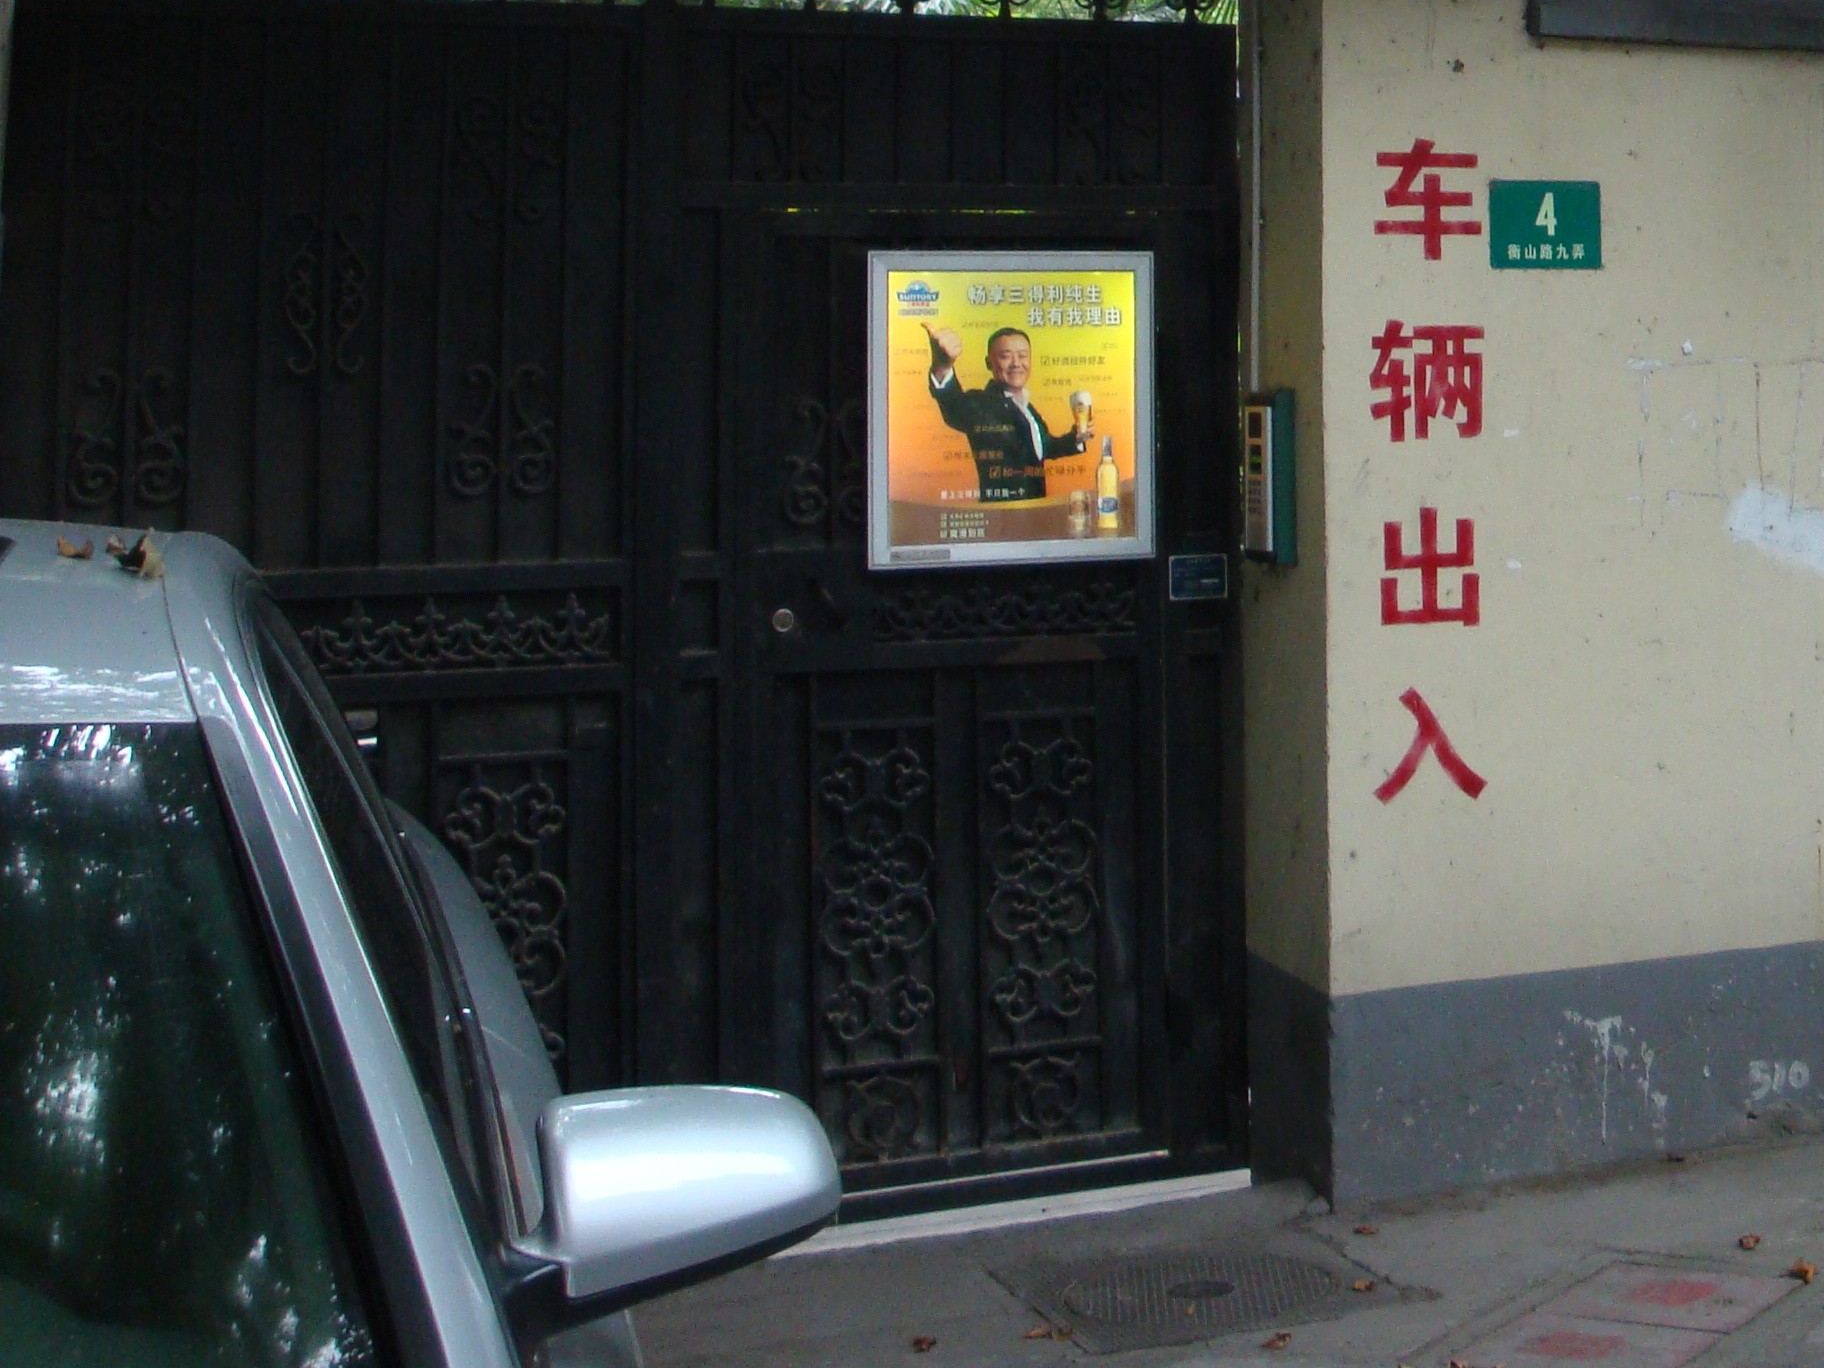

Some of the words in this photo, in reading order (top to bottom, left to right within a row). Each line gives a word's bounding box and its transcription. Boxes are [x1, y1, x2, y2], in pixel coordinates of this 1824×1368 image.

[1535, 192, 1557, 236] 4
[1507, 243, 1585, 260] 衡山路九弄
[967, 285, 1101, 305] 畅享三得利纯生
[1028, 307, 1121, 326] 我有我理由
[1369, 138, 1487, 803] 车辆出入
